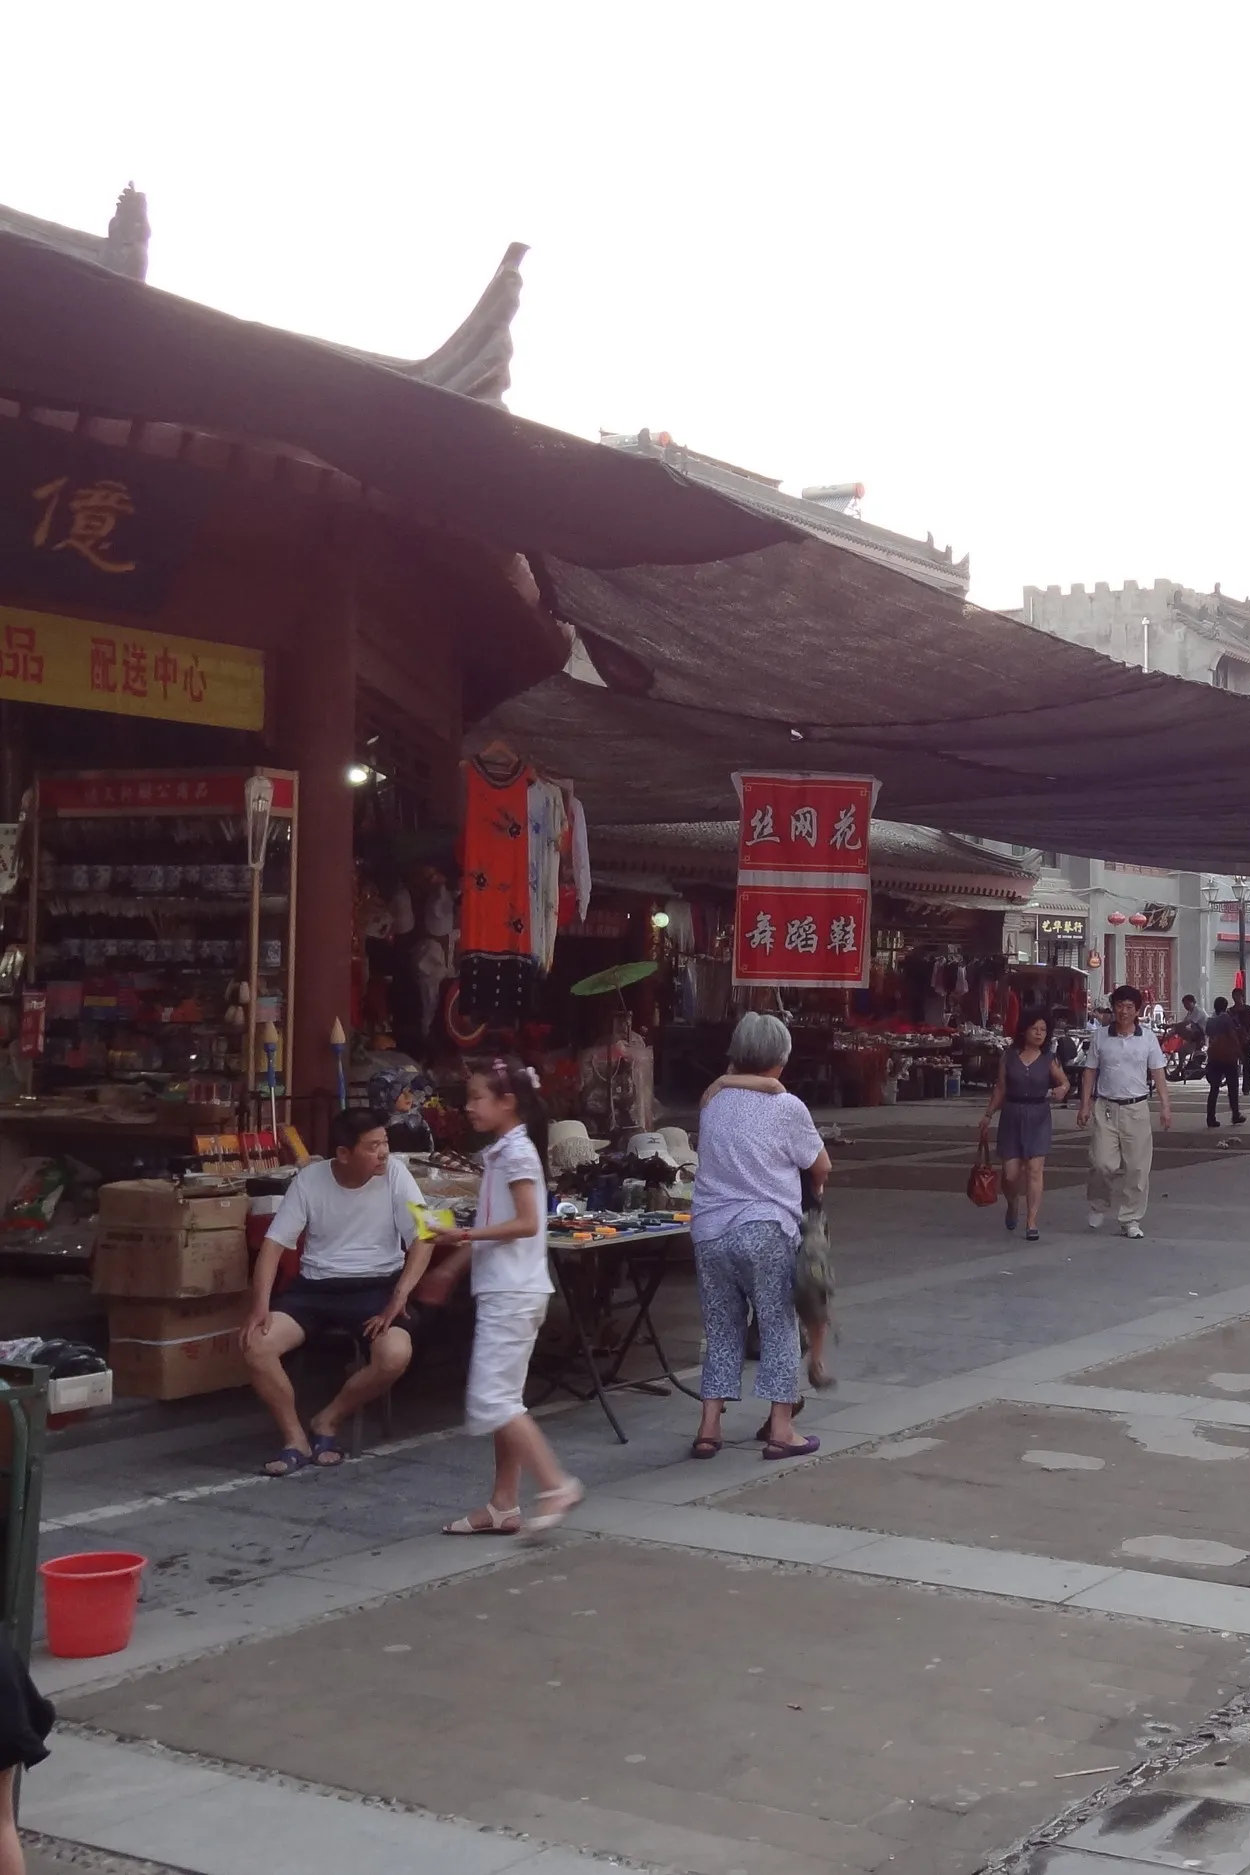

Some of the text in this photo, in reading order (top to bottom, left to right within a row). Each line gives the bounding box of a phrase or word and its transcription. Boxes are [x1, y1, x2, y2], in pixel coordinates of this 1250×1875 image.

[90, 636, 207, 702] 配送中心
[745, 803, 863, 850] 丝网花
[745, 910, 858, 956] 舞蹈鞋
